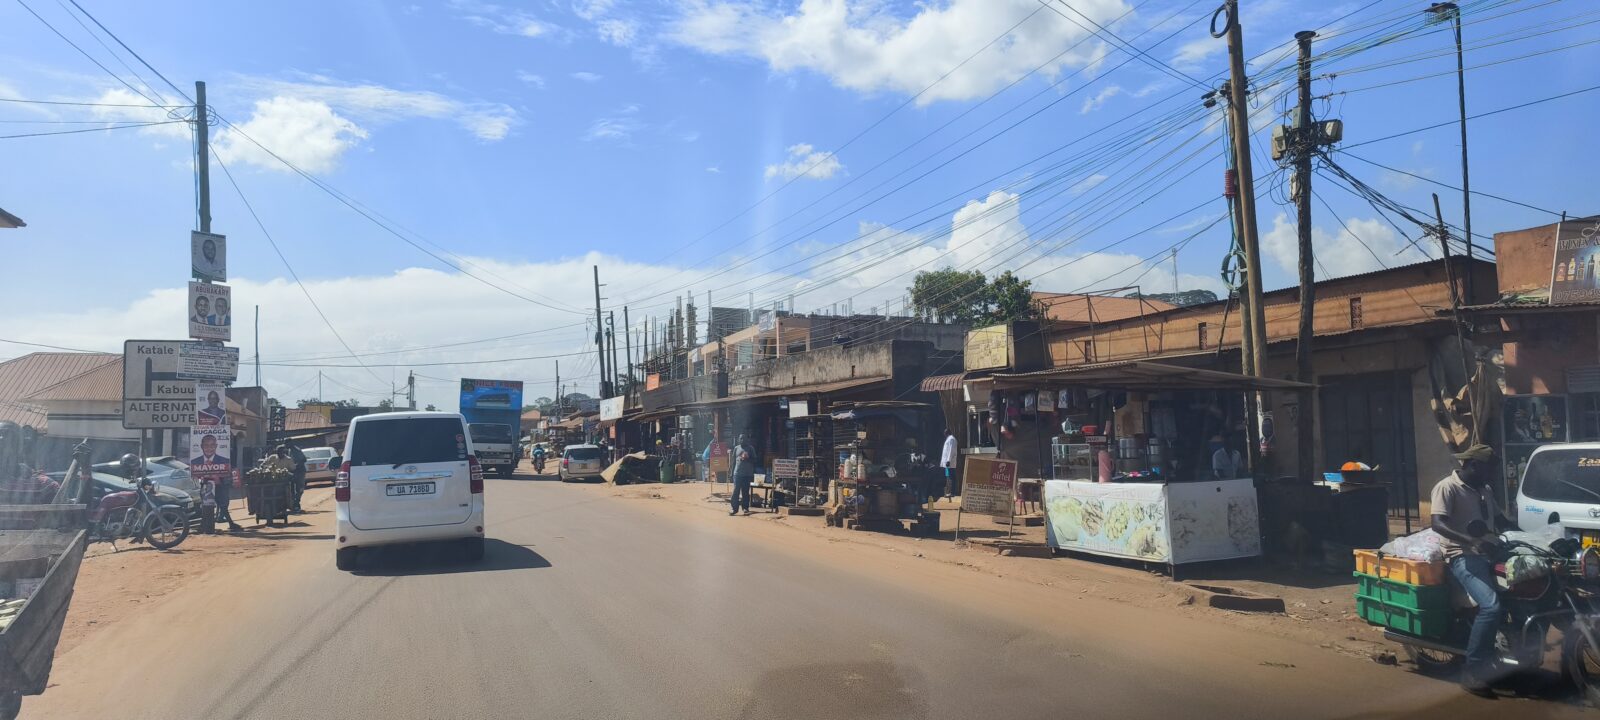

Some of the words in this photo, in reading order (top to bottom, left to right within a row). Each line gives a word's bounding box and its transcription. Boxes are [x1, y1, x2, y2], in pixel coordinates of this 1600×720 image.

[137, 345, 174, 355] Katale
[157, 385, 196, 394] Kabuu
[129, 402, 196, 412] ALTERNAT
[152, 413, 195, 423] ROUTE
[194, 463, 226, 471] MAYOR
[992, 472, 1011, 482] airtel
[397, 486, 405, 494] UA
